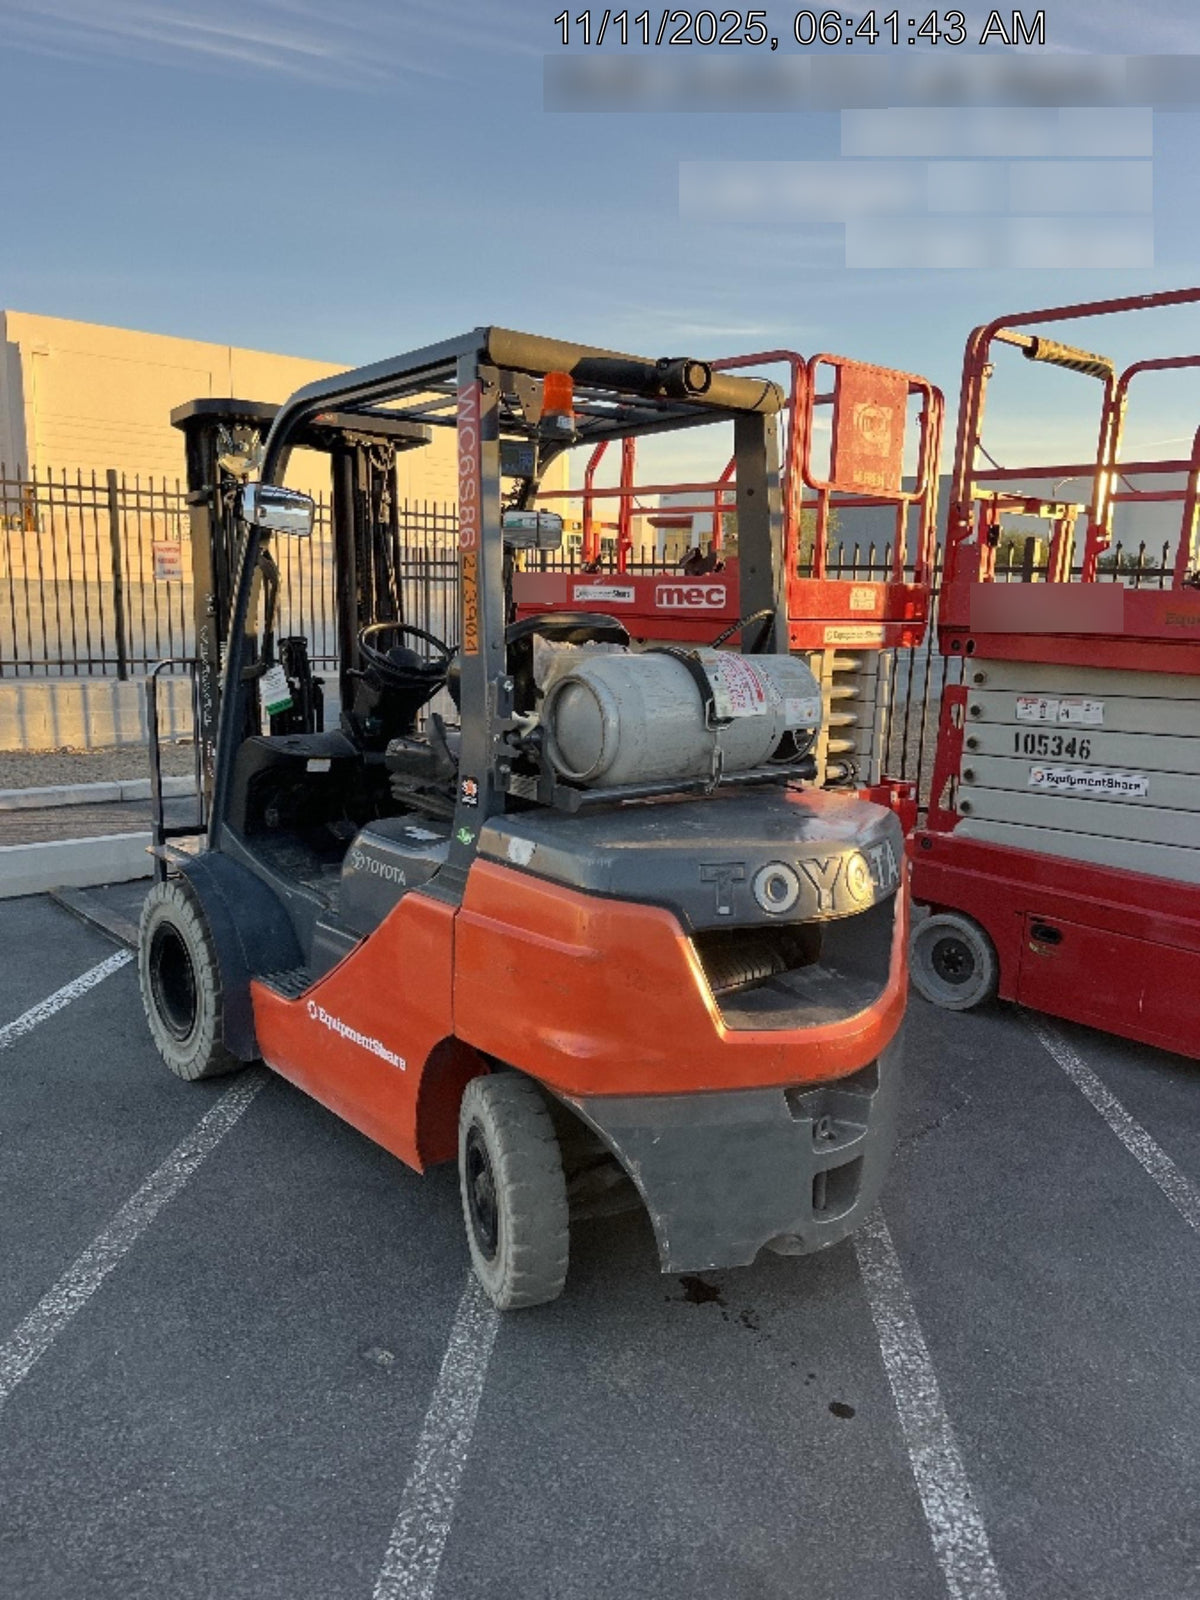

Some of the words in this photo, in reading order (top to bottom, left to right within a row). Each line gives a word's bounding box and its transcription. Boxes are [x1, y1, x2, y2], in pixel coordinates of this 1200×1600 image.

[657, 586, 725, 607] mec
[1014, 732, 1091, 760] 105346
[1046, 773, 1141, 791] EquipmentShare
[365, 856, 407, 886] TOYOTA
[699, 839, 899, 916] TOYOTA
[318, 1006, 407, 1072] EquipmentShare
